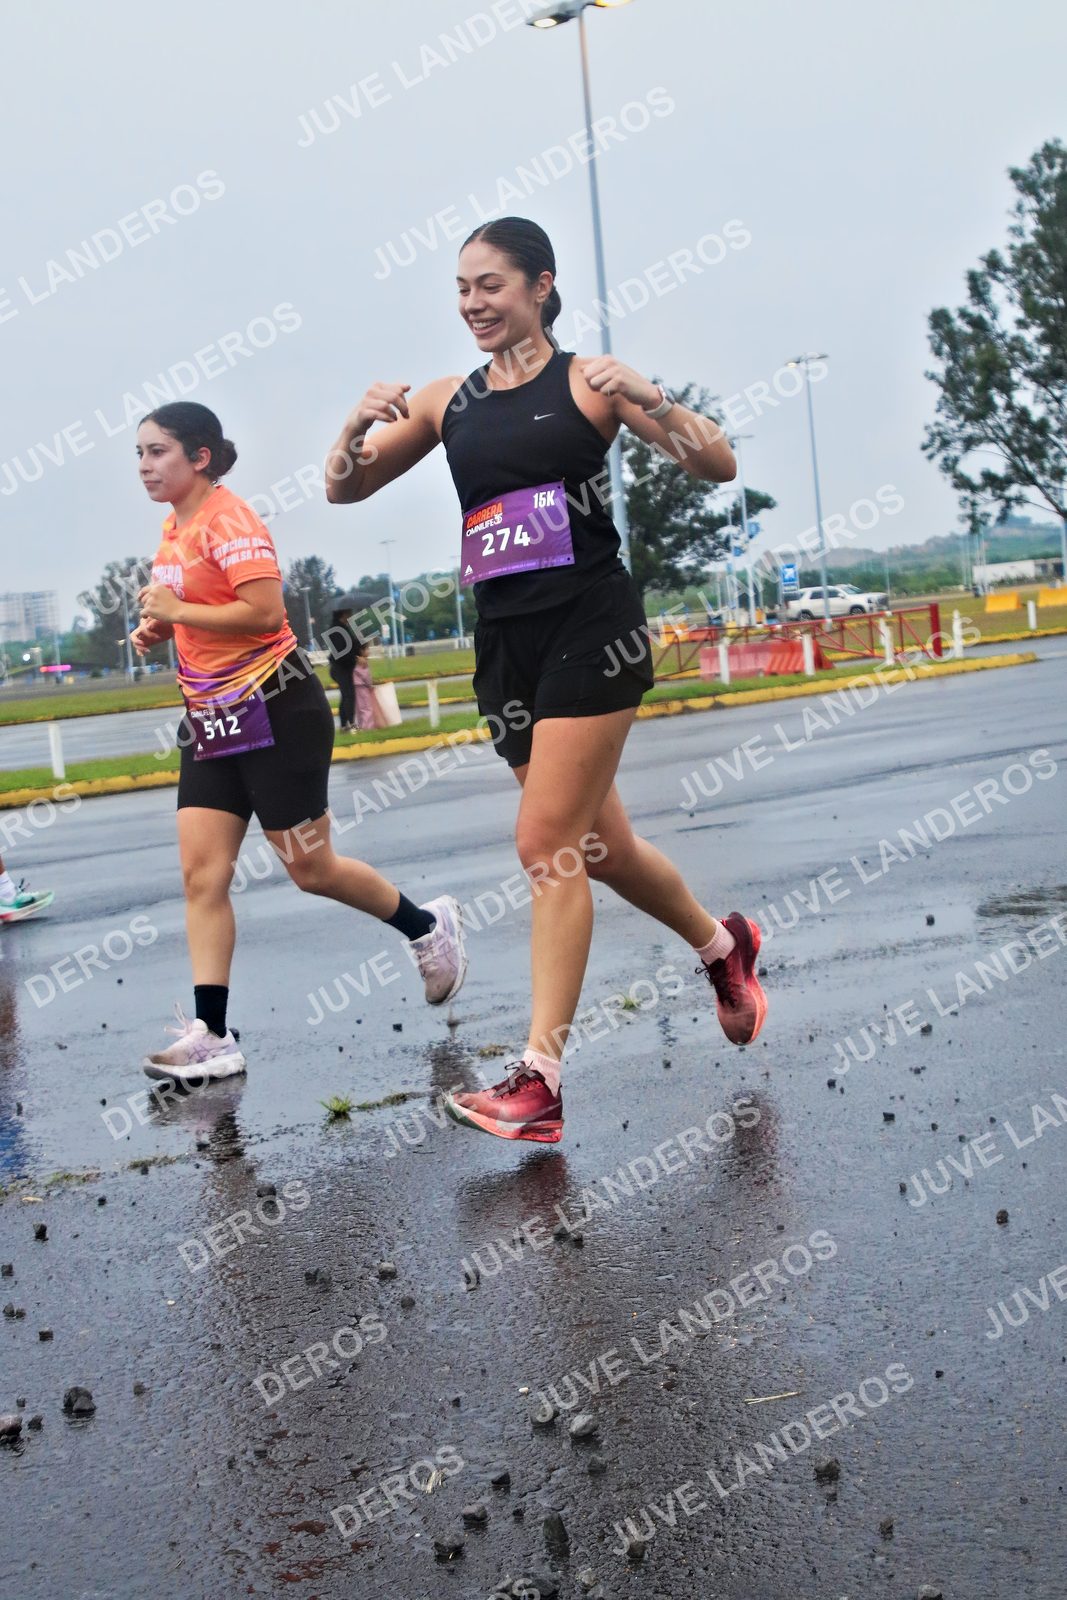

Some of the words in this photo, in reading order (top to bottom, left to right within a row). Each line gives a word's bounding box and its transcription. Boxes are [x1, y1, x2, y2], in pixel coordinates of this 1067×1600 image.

[533, 490, 555, 509] 15K
[466, 502, 503, 528] CARRERA
[481, 524, 531, 556] 274
[203, 715, 241, 740] 512
